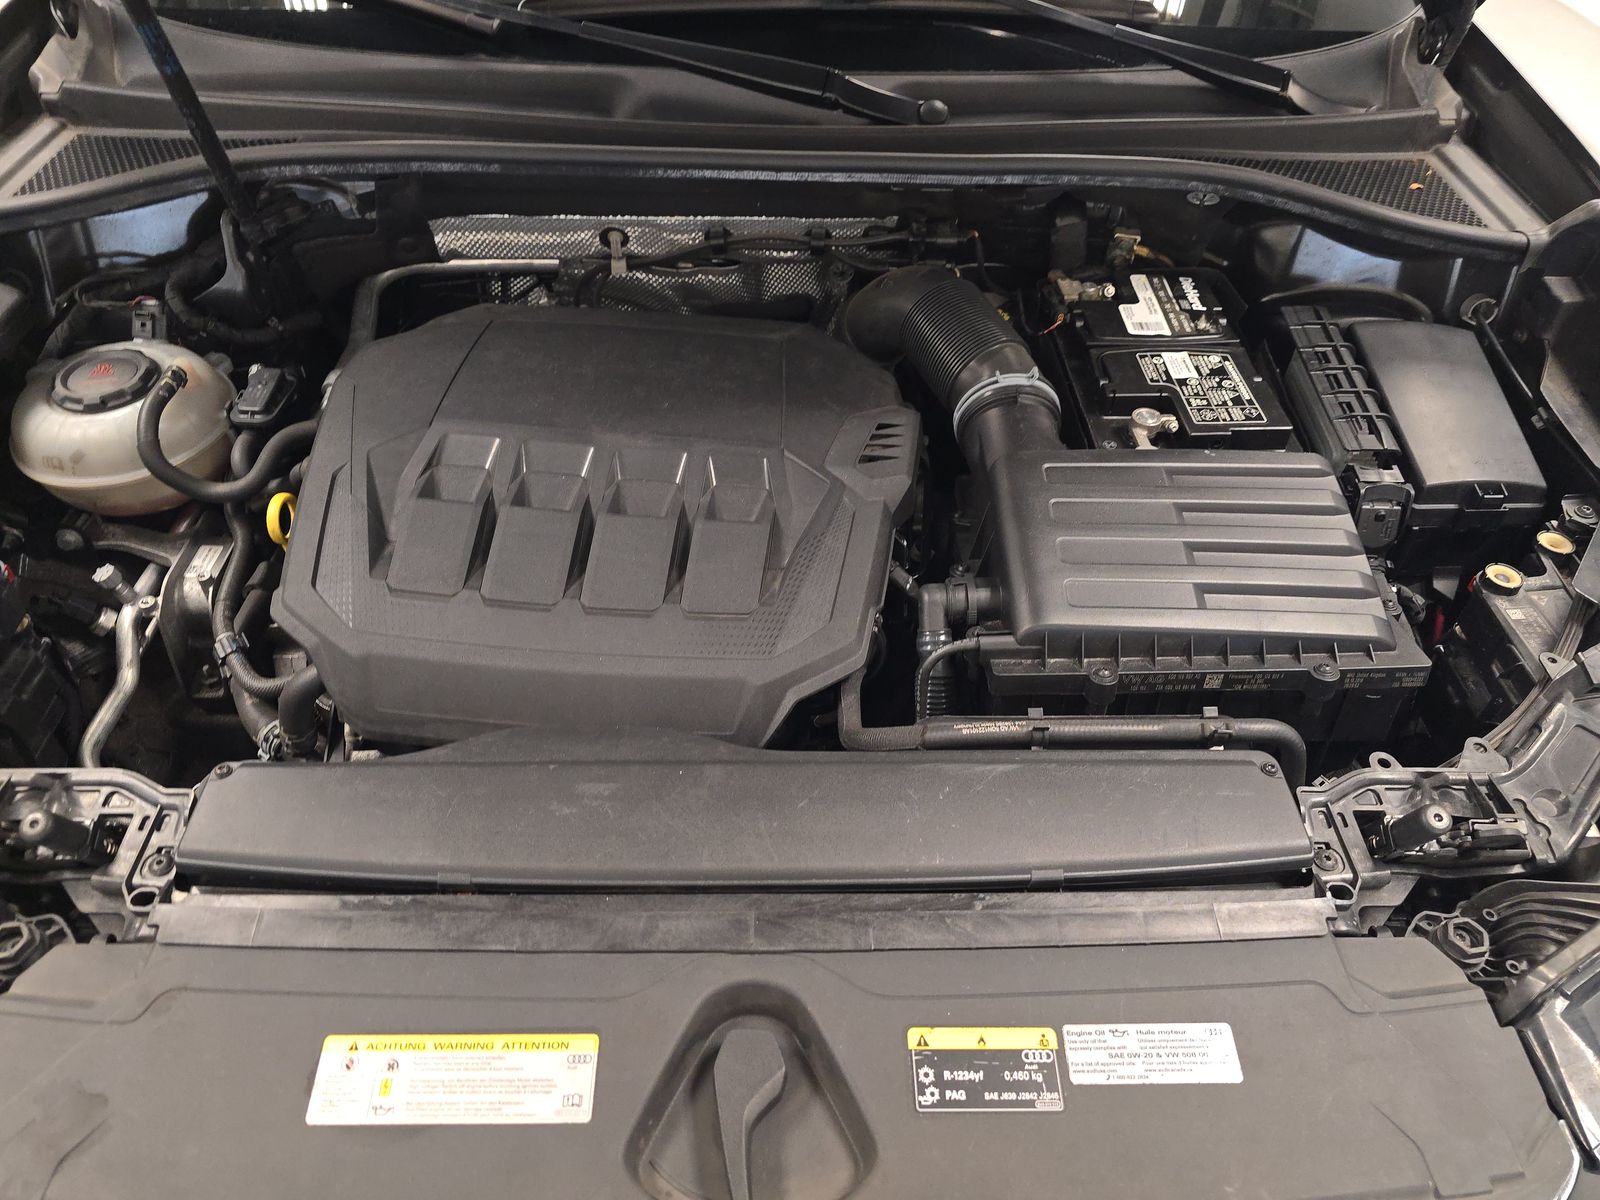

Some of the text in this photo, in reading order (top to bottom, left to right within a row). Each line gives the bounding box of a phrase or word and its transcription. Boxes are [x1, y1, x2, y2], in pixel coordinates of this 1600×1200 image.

[1178, 276, 1207, 311] DieHard
[1066, 1029, 1092, 1037] Engine
[366, 1040, 570, 1051] ACHTUNG WARNING ATTENTION
[944, 1070, 984, 1082] R-1234yf
[1031, 1070, 1043, 1082] kg
[946, 1090, 966, 1100] PAG
[984, 1092, 999, 1100] SAE
